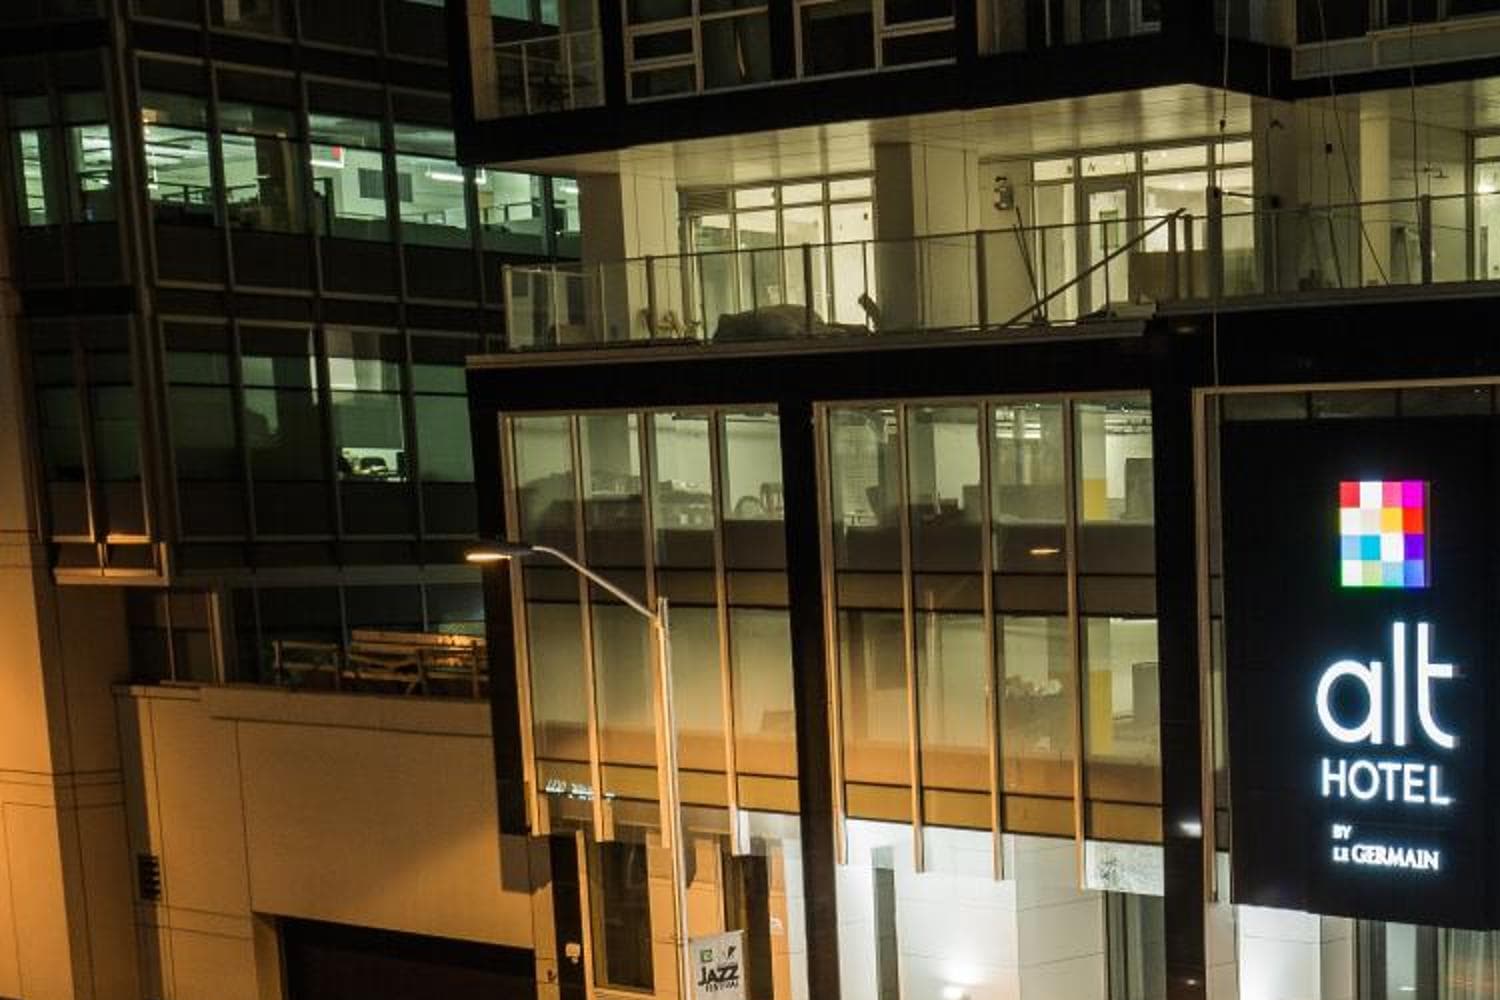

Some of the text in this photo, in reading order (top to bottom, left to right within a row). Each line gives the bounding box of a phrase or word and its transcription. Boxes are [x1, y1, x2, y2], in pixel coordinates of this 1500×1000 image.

[1316, 621, 1455, 748] alt
[1321, 757, 1453, 805] HOTEL
[1332, 823, 1351, 839] BY
[1351, 843, 1440, 870] GERMAIN
[698, 964, 739, 986] JAZZ
